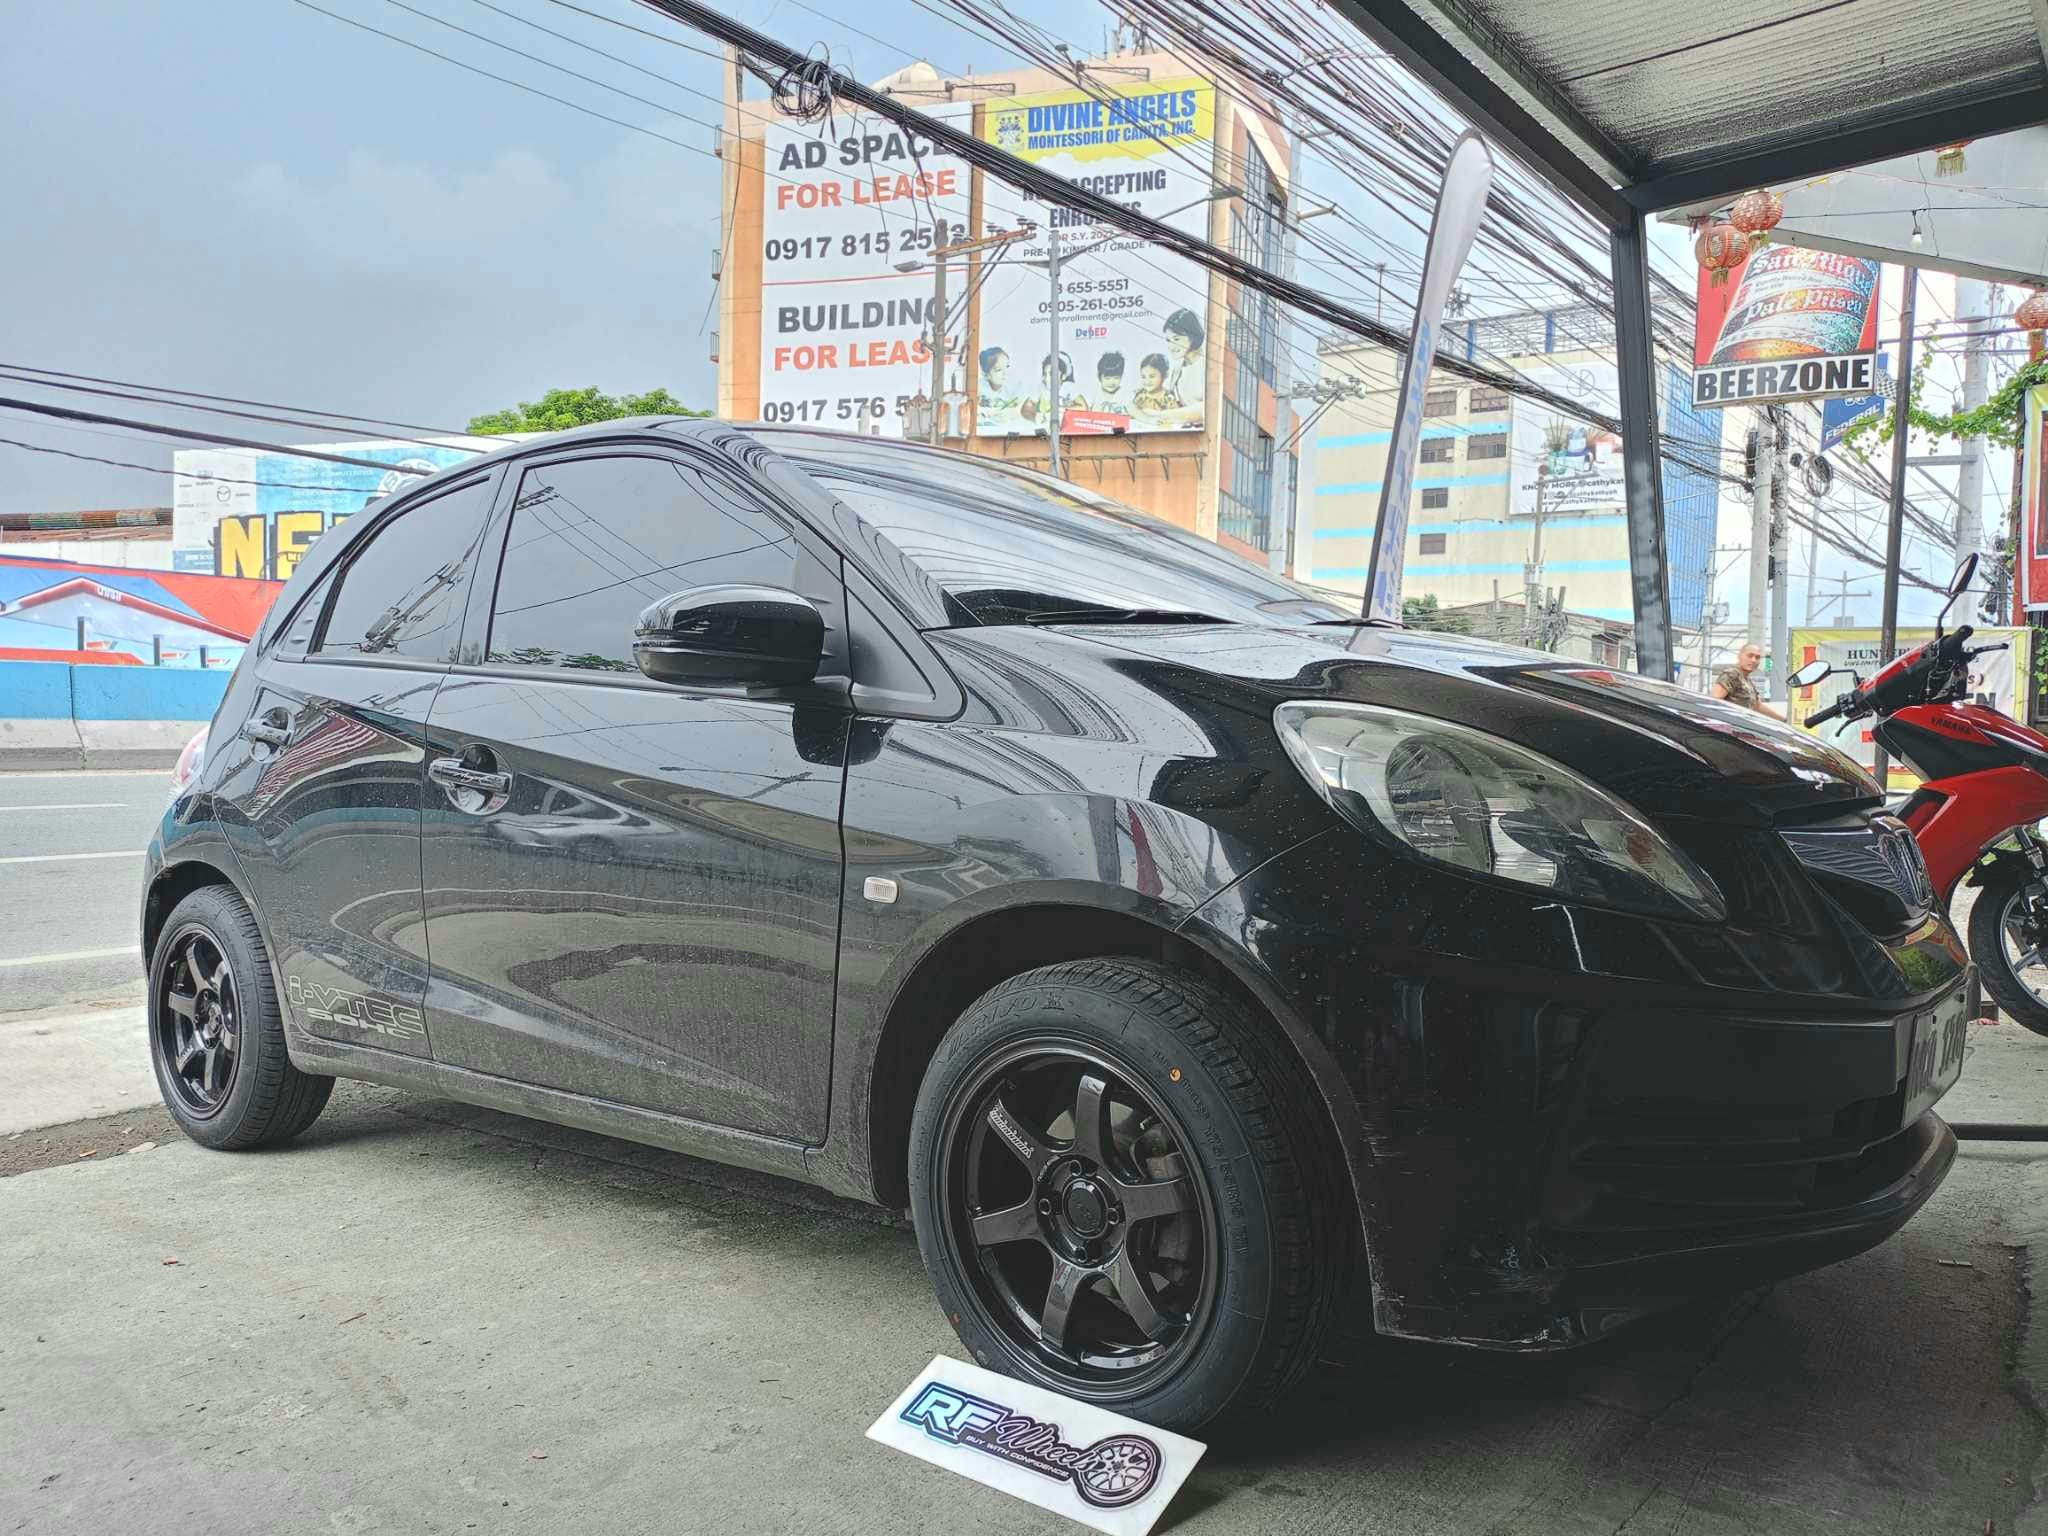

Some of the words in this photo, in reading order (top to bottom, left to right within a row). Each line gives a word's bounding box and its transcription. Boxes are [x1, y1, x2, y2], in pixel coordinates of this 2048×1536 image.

[1028, 100, 1103, 133] DIVINE
[1108, 90, 1196, 125] ANGELS
[1028, 130, 1103, 150] MONTESSORI
[1106, 128, 1121, 143] OF
[779, 141, 827, 171] AD
[777, 182, 842, 210] FOR
[853, 169, 956, 204] LEASE
[765, 236, 832, 261] 0917
[841, 232, 890, 256] 815
[1067, 279, 1129, 294] 655-5551
[778, 297, 950, 333] BUILDING
[774, 345, 838, 371] FOR
[1697, 359, 1869, 401] BEERZONE
[763, 399, 828, 423] 0917
[837, 396, 885, 420] 576
[911, 1387, 1006, 1434] RF
[996, 1418, 1099, 1474] Wheels
[966, 1434, 985, 1446] BUY
[986, 1442, 1010, 1456] WITH
[1009, 1452, 1071, 1479] CONFIDENCE
